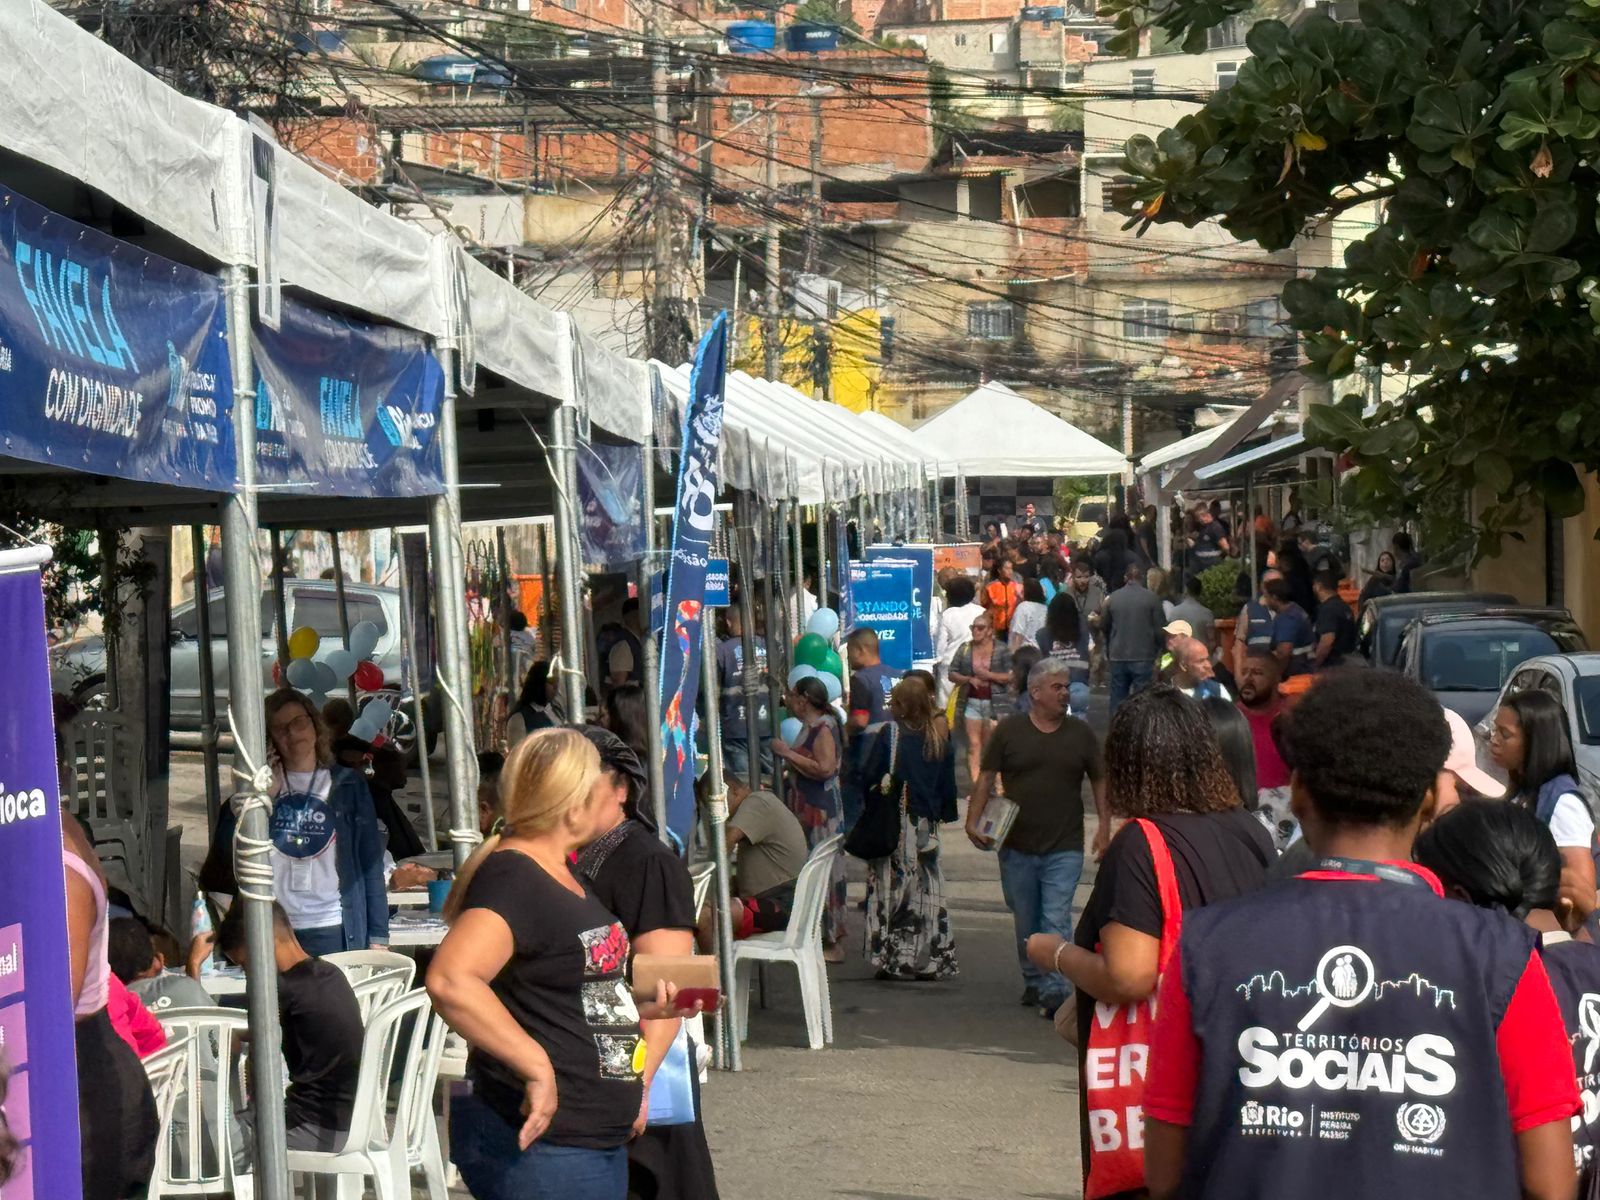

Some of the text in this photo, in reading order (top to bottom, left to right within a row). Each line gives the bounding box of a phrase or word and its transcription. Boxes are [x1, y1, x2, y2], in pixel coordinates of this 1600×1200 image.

[16, 240, 140, 374] FAVELA
[45, 367, 79, 424] COM
[1087, 1043, 1149, 1090] ER
[1238, 1027, 1457, 1096] SOCIAIS
[1282, 1032, 1404, 1053] TERRITÓRIOS
[1266, 1105, 1304, 1128] Rio
